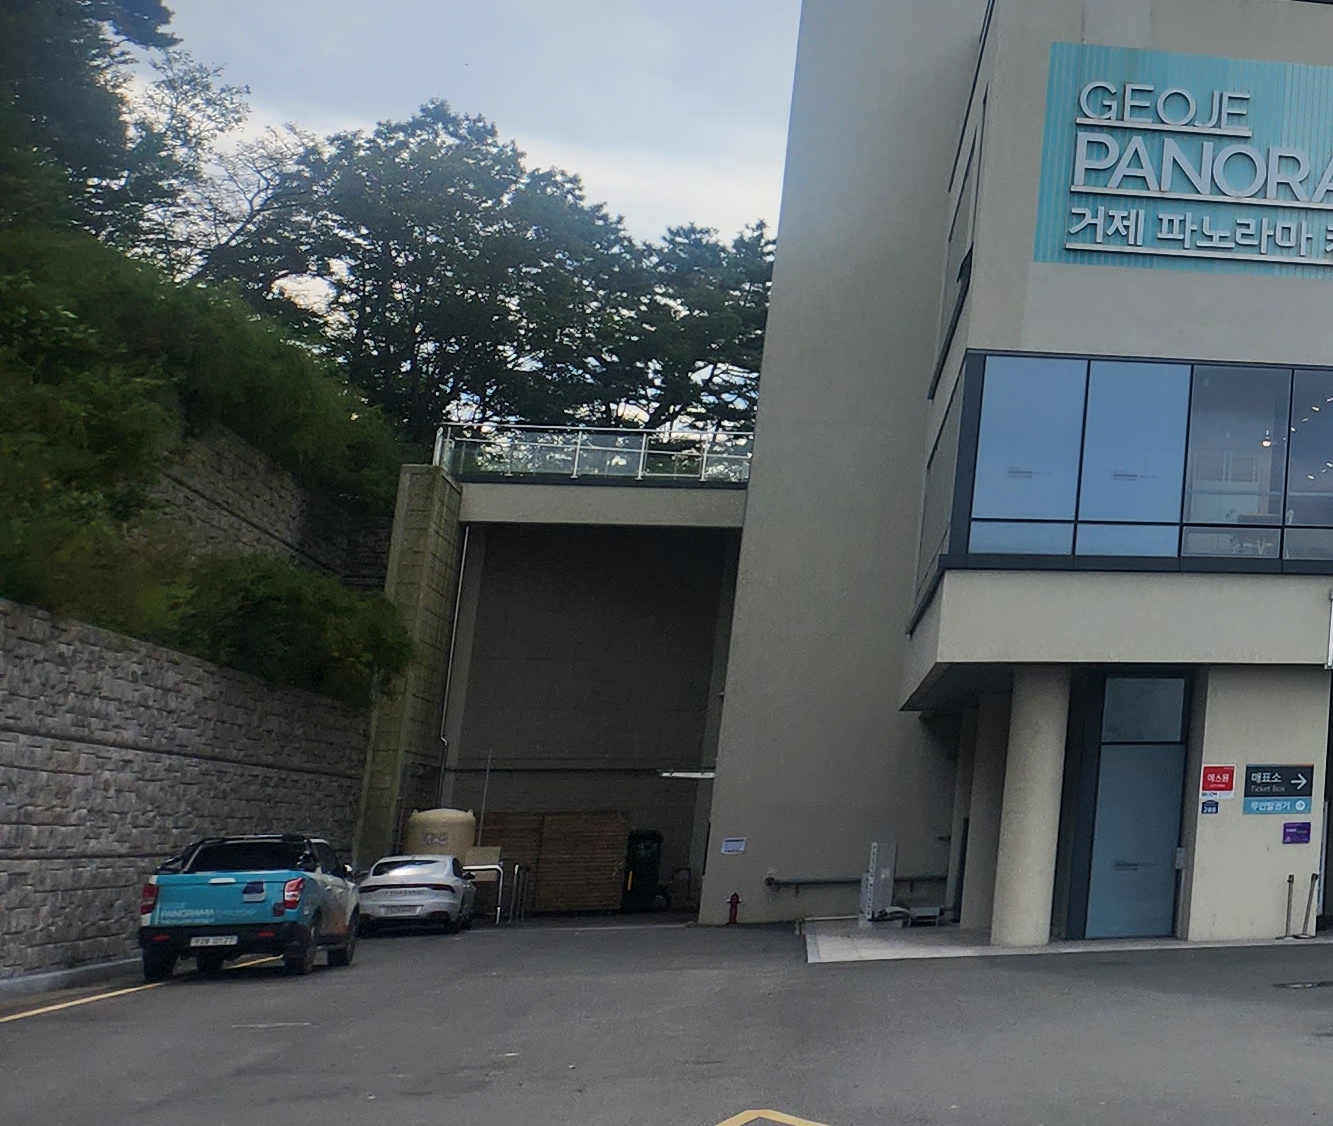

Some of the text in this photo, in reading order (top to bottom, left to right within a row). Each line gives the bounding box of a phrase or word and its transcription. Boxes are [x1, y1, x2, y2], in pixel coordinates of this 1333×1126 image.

[1079, 81, 1251, 131] GEOJE
[1068, 205, 1146, 247] 거제
[1156, 211, 1314, 258] 파노라마
[1250, 772, 1282, 784] 매표소
[1250, 785, 1271, 793] Ticket
